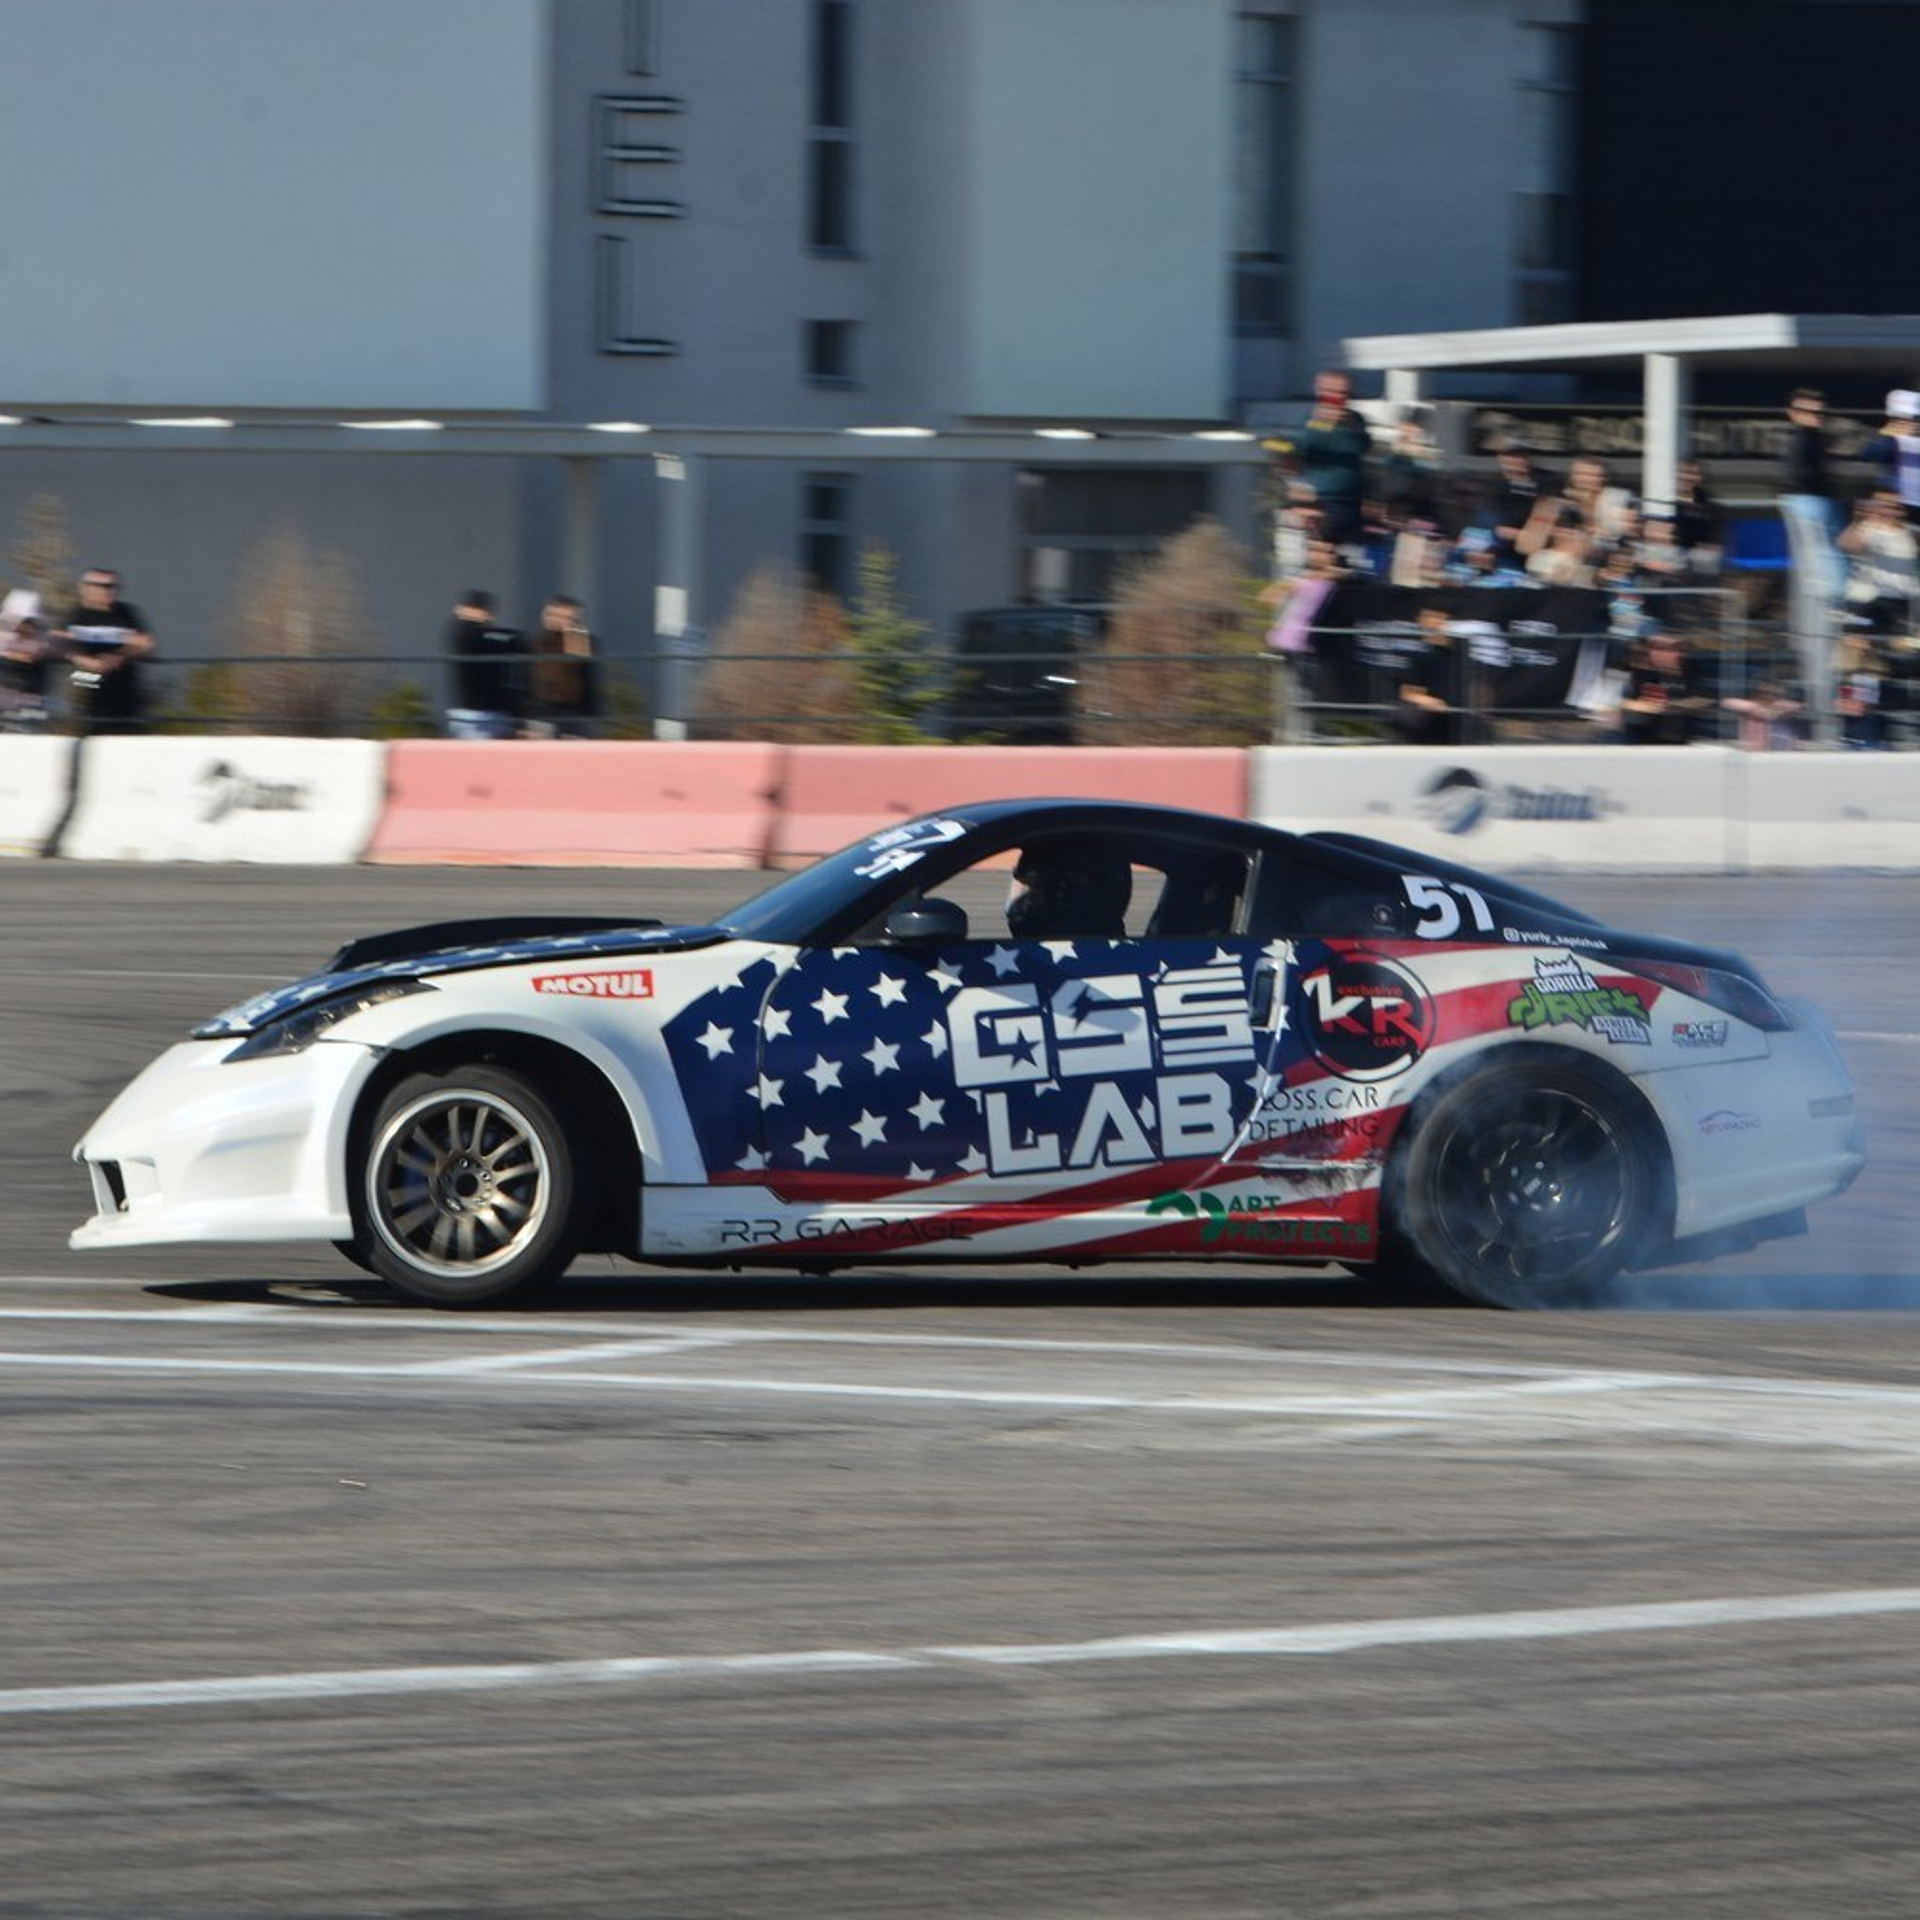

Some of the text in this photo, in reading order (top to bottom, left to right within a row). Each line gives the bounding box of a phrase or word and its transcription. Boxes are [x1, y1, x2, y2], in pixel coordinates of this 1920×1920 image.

[1401, 874, 1495, 939] 51
[541, 973, 650, 996] MOTUL
[1533, 973, 1599, 993] GORILLA
[946, 965, 1256, 1088] GSS
[1372, 1035, 1408, 1048] CARS
[985, 1072, 1236, 1174] LAB
[1249, 1114, 1379, 1142] DETAILING
[1228, 1195, 1282, 1214] ART
[721, 1217, 973, 1244] RR GARAGE
[1226, 1221, 1371, 1244] PROJECTS
